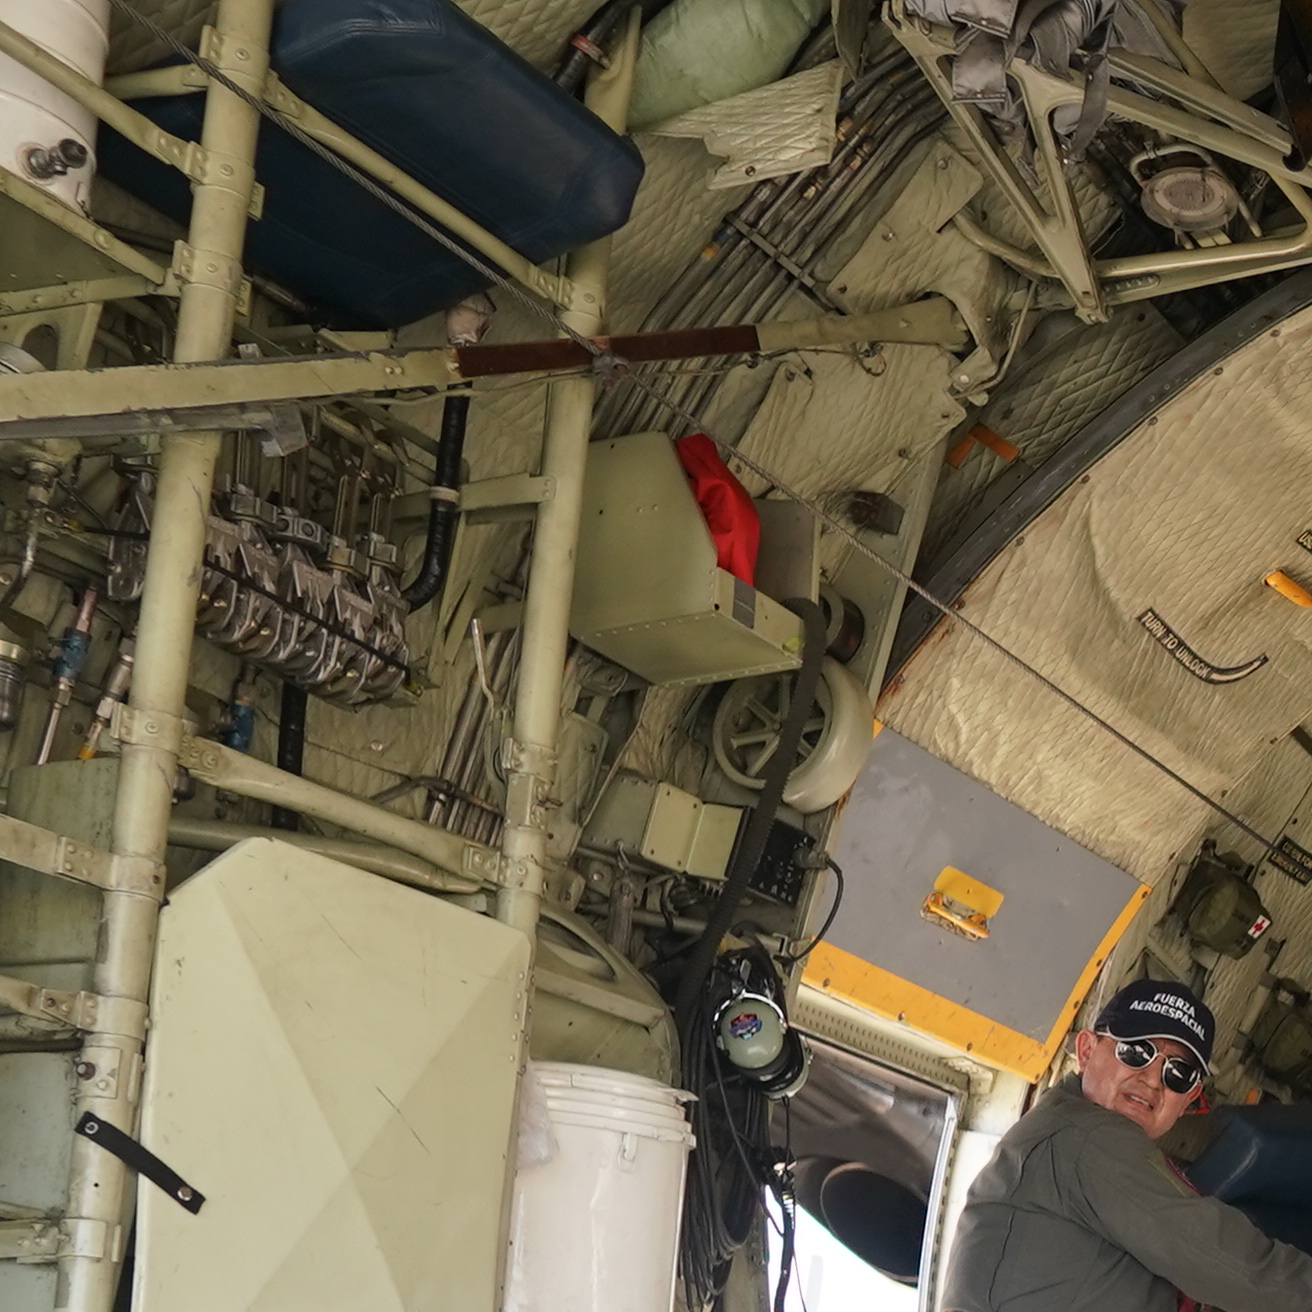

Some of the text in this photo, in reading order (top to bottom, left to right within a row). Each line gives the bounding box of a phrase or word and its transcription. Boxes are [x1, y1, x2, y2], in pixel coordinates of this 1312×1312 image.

[1140, 611, 1213, 679] TURN TO UNLOCK
[1129, 1000, 1206, 1041] AEROESPACIAL
[1153, 993, 1196, 1018] FUERZA
